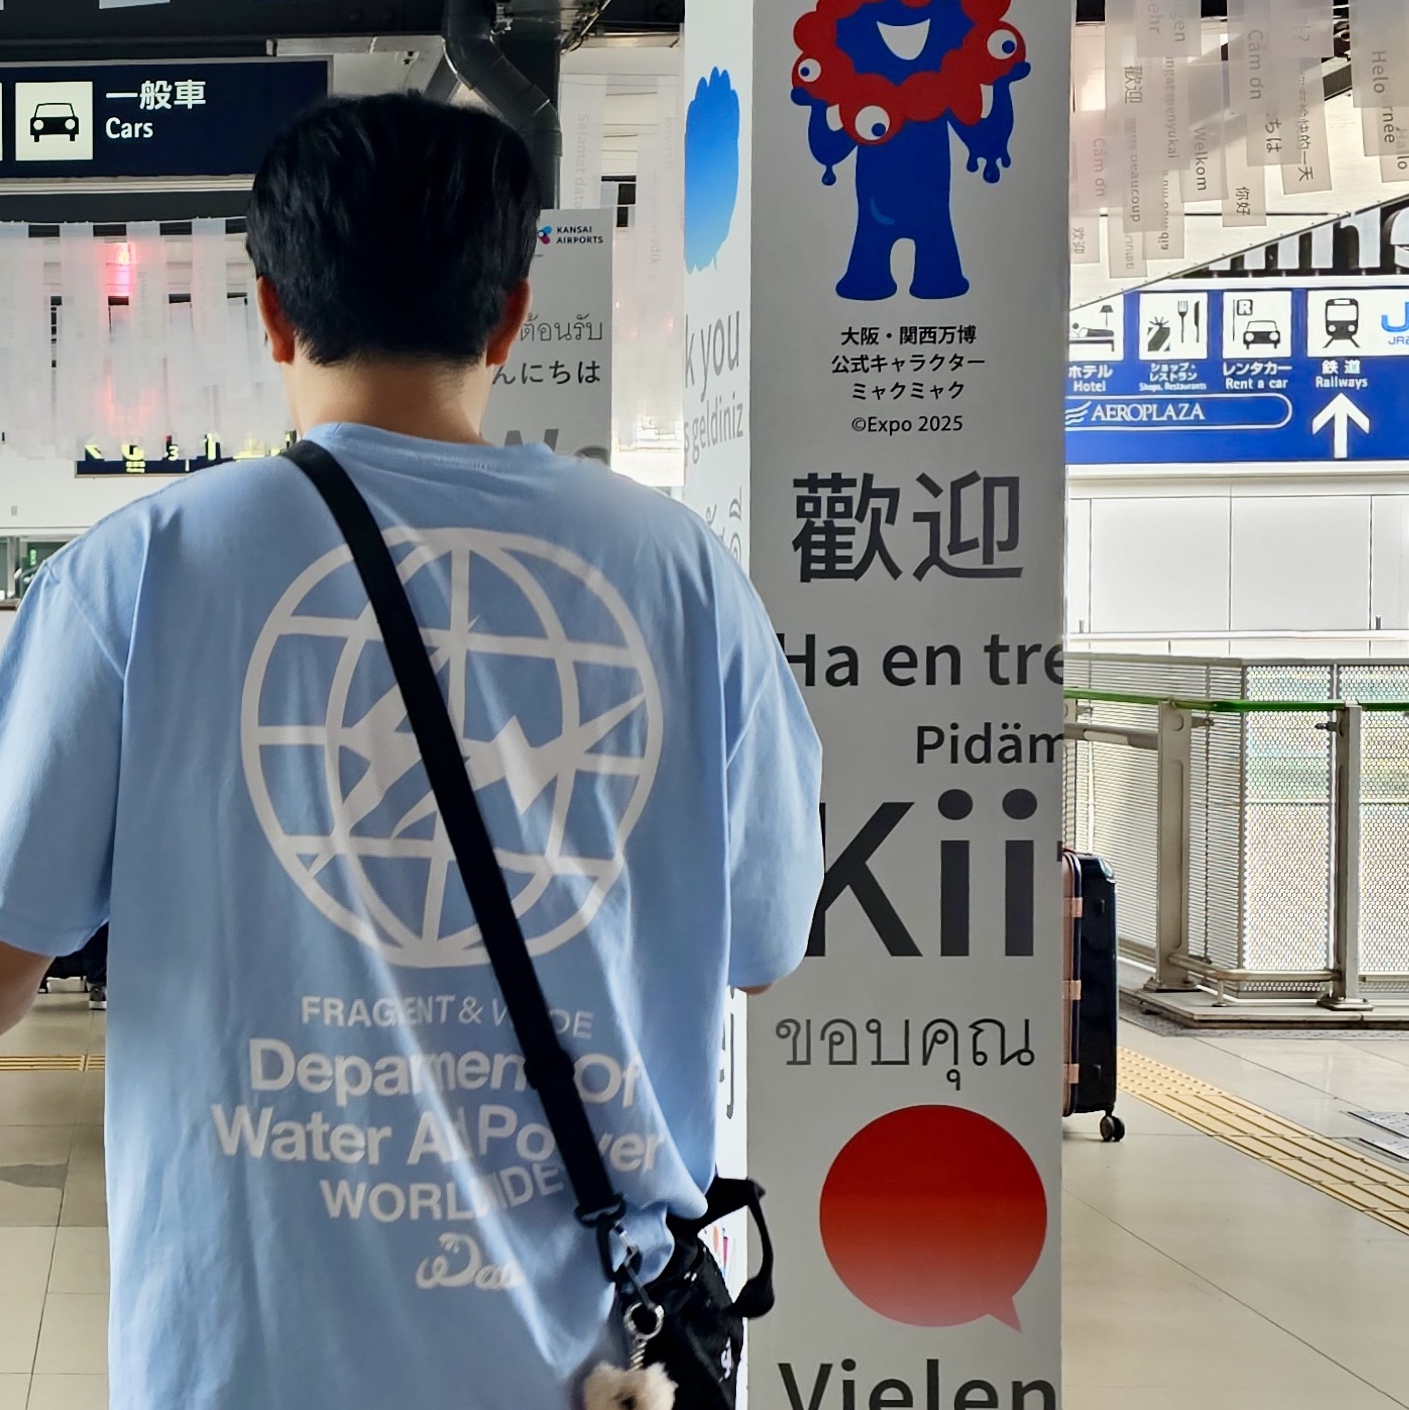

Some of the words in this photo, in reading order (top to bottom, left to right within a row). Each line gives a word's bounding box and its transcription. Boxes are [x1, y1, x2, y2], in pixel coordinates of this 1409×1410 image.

[105, 80, 206, 109] 一般車
[105, 116, 154, 139] Cars
[1193, 127, 1211, 192] Welkom
[556, 226, 593, 234] KANSAI
[556, 236, 604, 244] AIRPORTS
[840, 325, 977, 346] 大阪・関西万博
[700, 310, 741, 402] you
[831, 354, 985, 374] 公式キャラクター
[1068, 364, 1114, 379] ホテル
[1149, 372, 1198, 382] レストラン
[1222, 361, 1293, 376] レンタカー
[852, 381, 965, 401] ミャクミャク
[1073, 380, 1107, 392] Hotel
[1225, 378, 1254, 390] Rent
[1257, 379, 1265, 389] a
[1268, 378, 1289, 389] car
[1315, 376, 1368, 390] Railways
[1090, 402, 1206, 422] AEROPLAZA
[691, 390, 744, 465] geldiniz
[852, 416, 912, 436] ©Expo
[918, 415, 963, 432] 2025
[791, 470, 1024, 584] 歡迎
[775, 633, 859, 687] Ha
[882, 642, 961, 687] en
[806, 788, 1062, 957] Kii
[458, 995, 483, 1025] &
[775, 1016, 1036, 1092] ขอบคุณ
[574, 1053, 642, 1108] Of
[211, 1103, 392, 1166] Water
[477, 1104, 666, 1174] Poer
